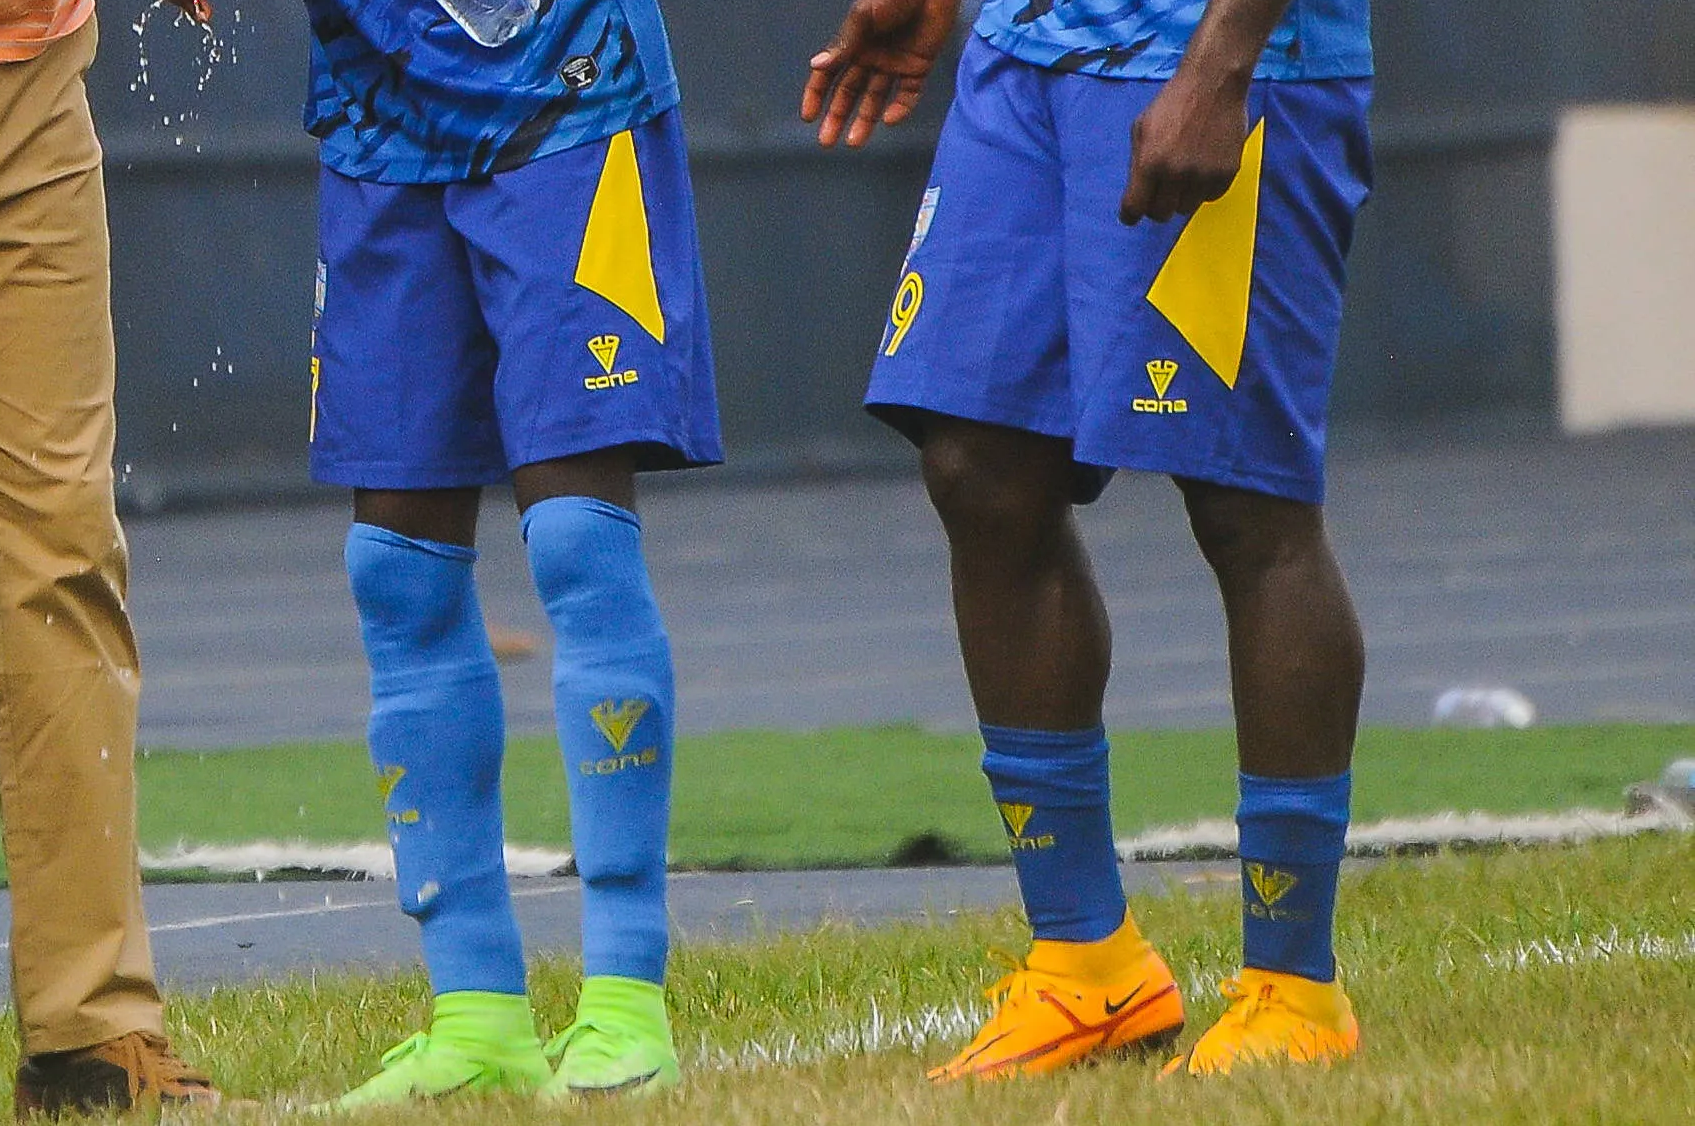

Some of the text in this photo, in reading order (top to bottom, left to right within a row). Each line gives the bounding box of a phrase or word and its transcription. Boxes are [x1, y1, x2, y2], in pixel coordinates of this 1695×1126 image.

[884, 271, 924, 356] 9
[584, 369, 639, 390] cone
[1132, 398, 1188, 414] cone
